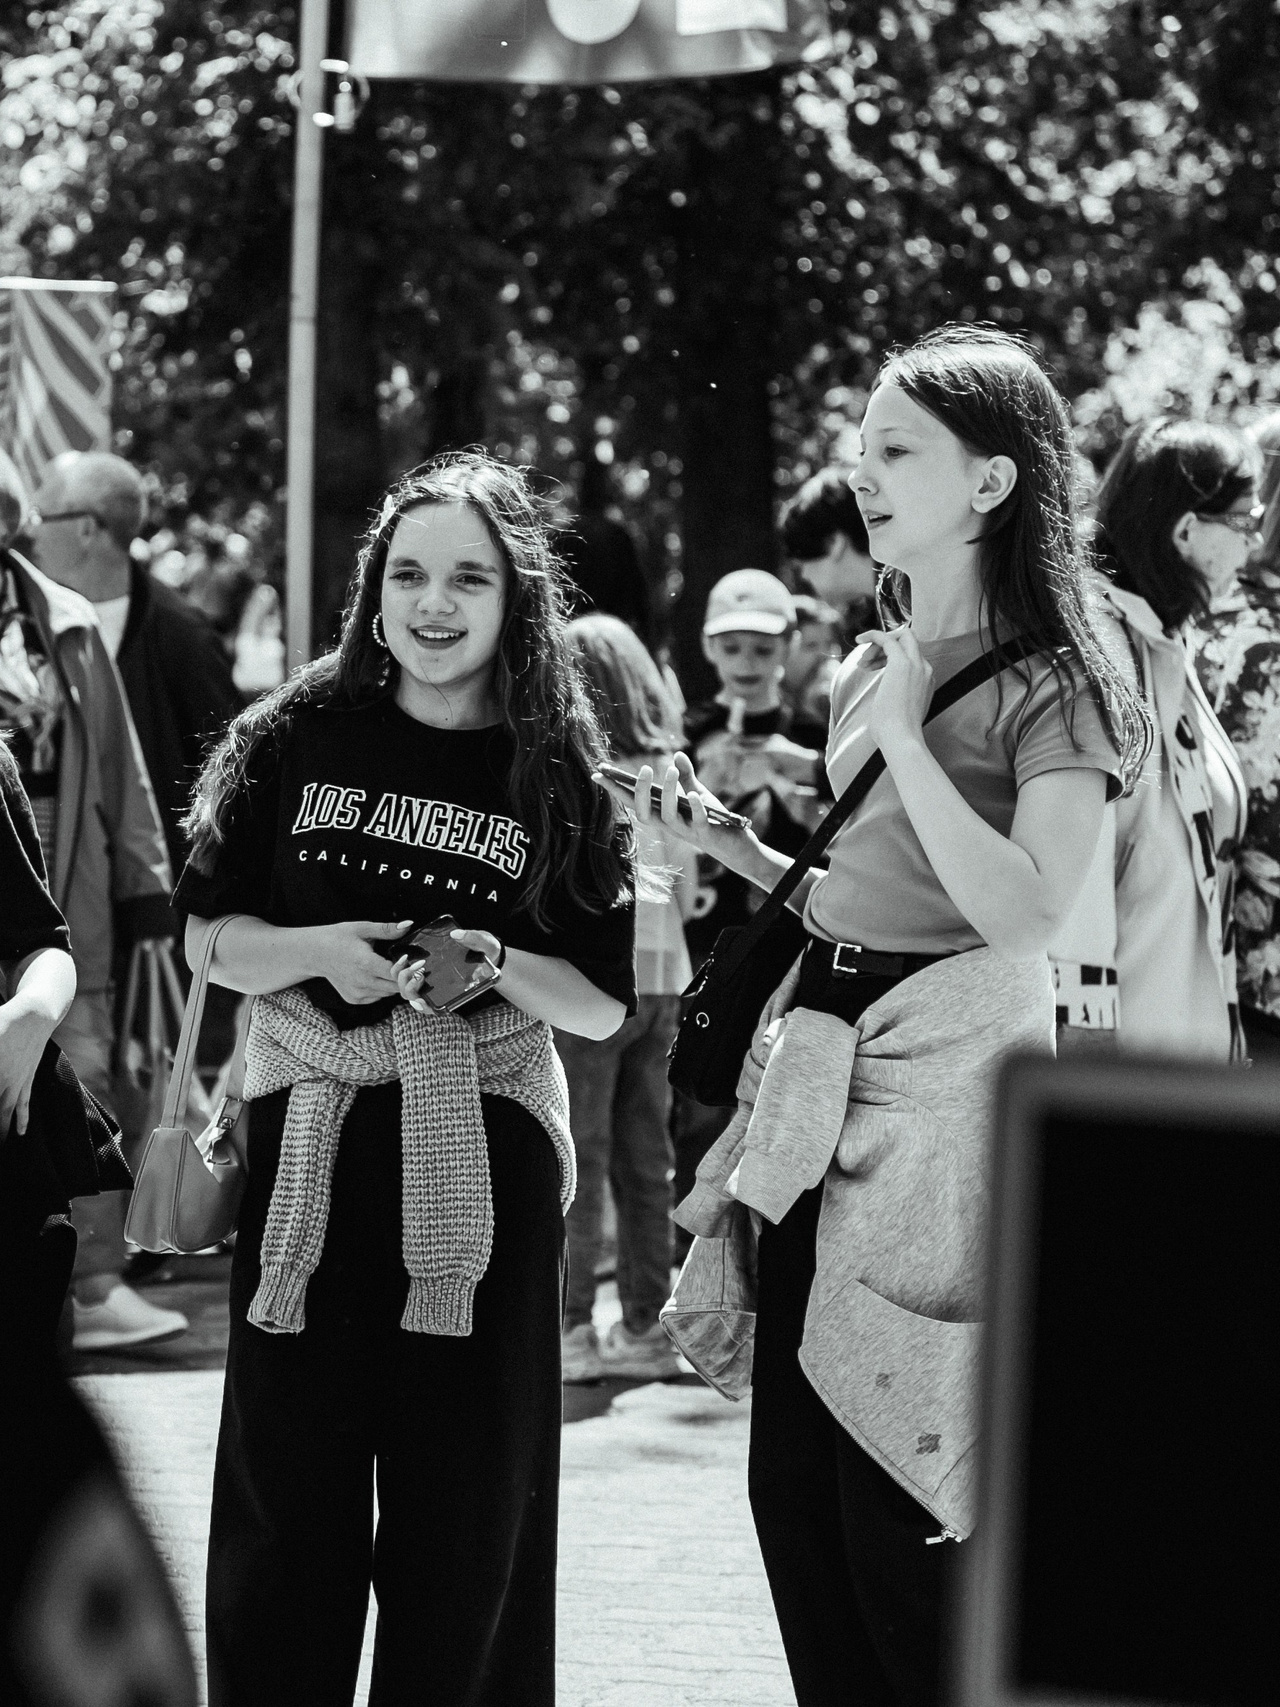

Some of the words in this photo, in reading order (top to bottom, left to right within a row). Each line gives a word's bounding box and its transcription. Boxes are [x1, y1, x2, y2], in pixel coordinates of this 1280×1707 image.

[292, 783, 366, 834] LOS
[363, 793, 530, 880] ANGELES
[298, 849, 499, 902] CALIFORNIA
